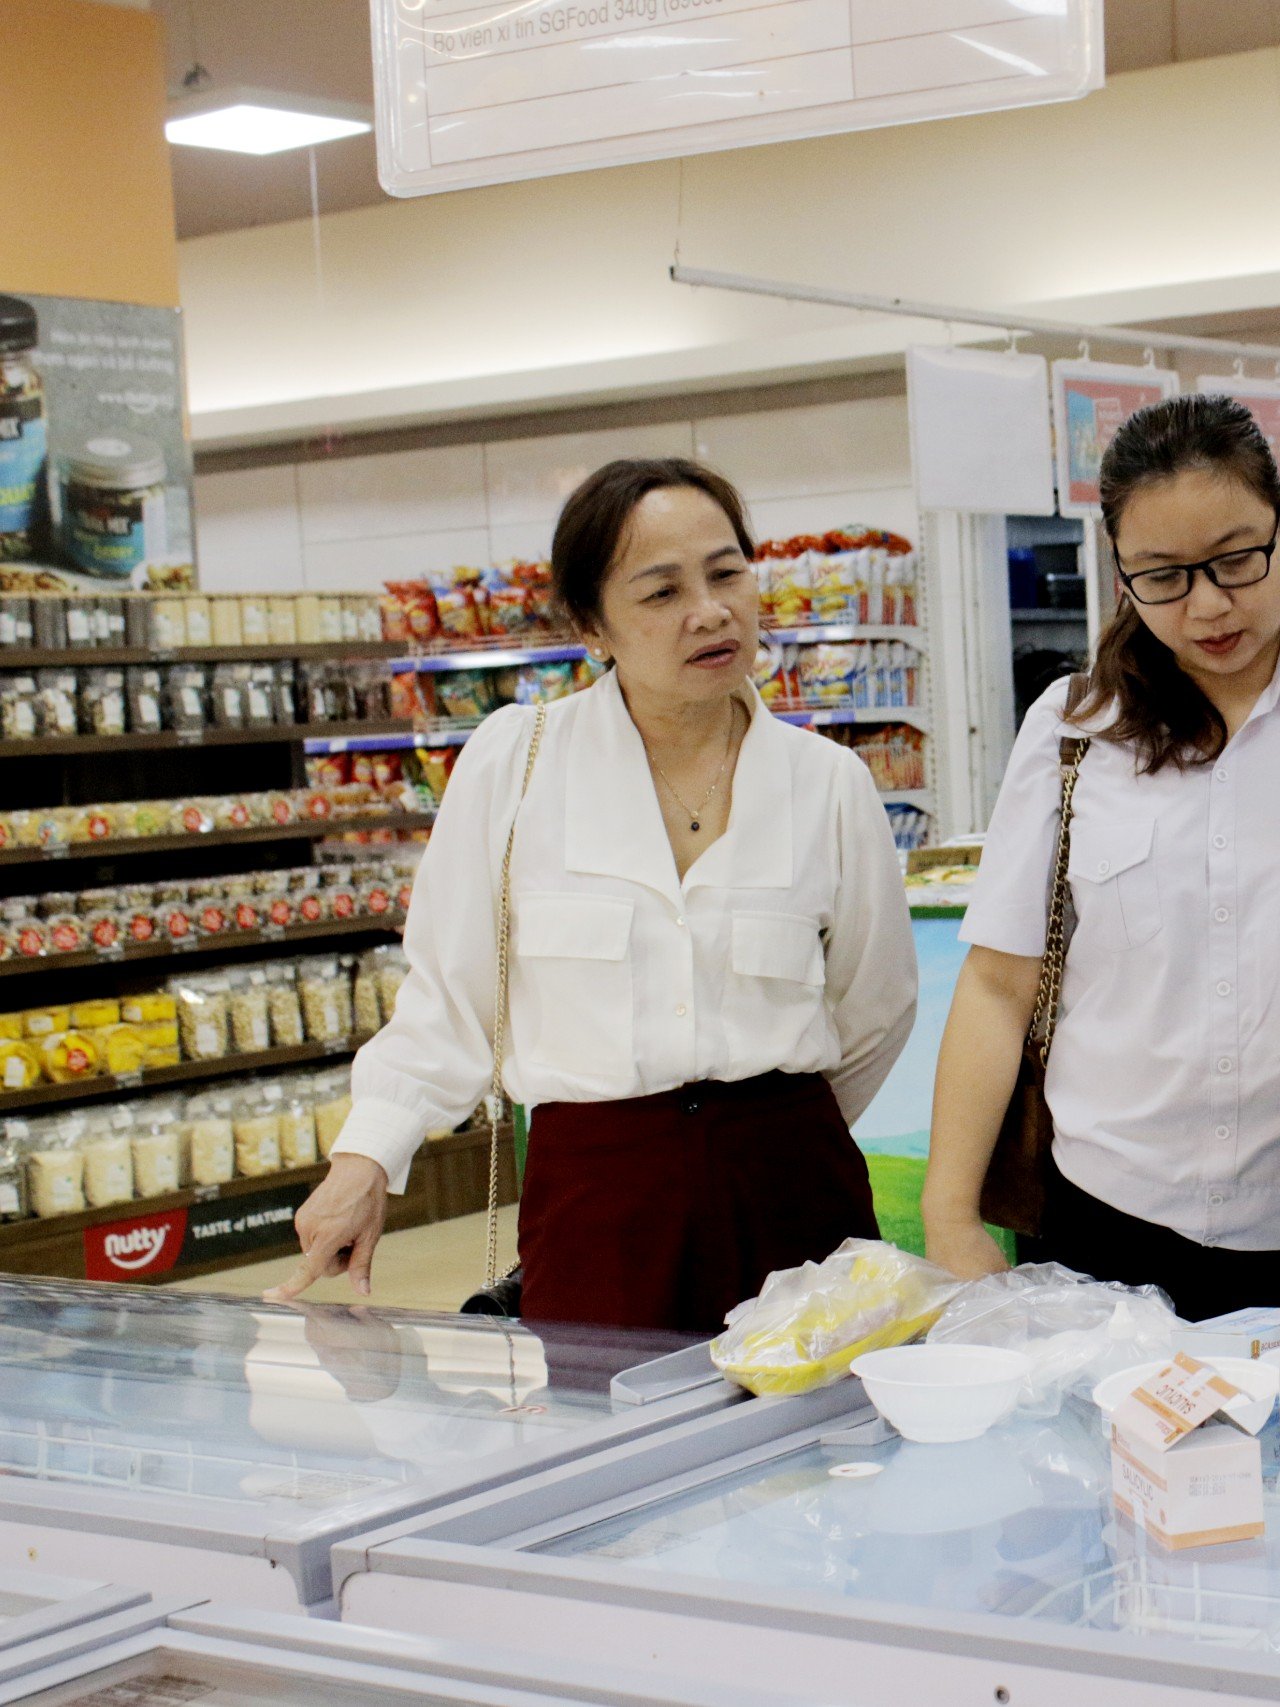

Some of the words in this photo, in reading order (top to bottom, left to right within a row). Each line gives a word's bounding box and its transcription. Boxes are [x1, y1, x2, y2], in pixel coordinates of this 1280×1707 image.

[539, 6, 609, 34] SGFood
[192, 1219, 231, 1239] TASTE
[105, 1226, 168, 1270] nutty
